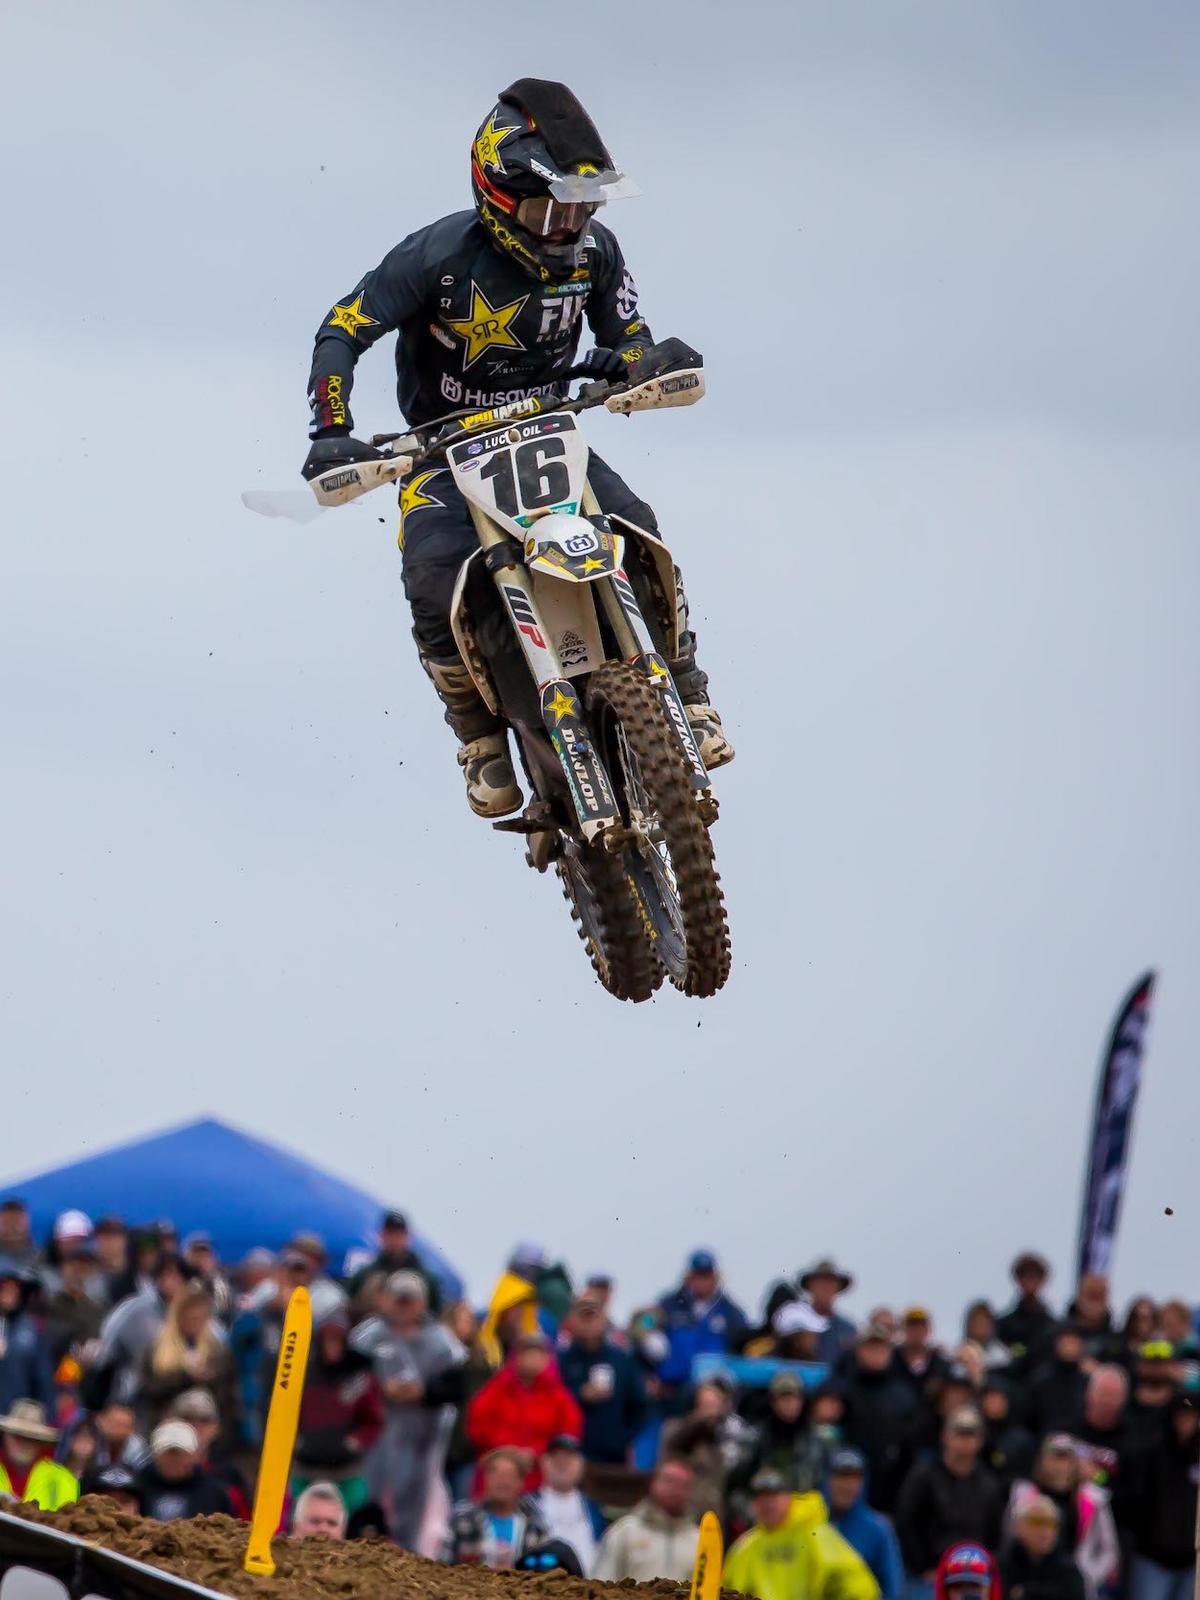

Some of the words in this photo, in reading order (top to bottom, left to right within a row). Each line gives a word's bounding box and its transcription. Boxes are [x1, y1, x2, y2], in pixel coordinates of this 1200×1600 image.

[522, 424, 541, 437] OIL
[480, 437, 571, 518] 16
[280, 1331, 297, 1390] ACERBIS
